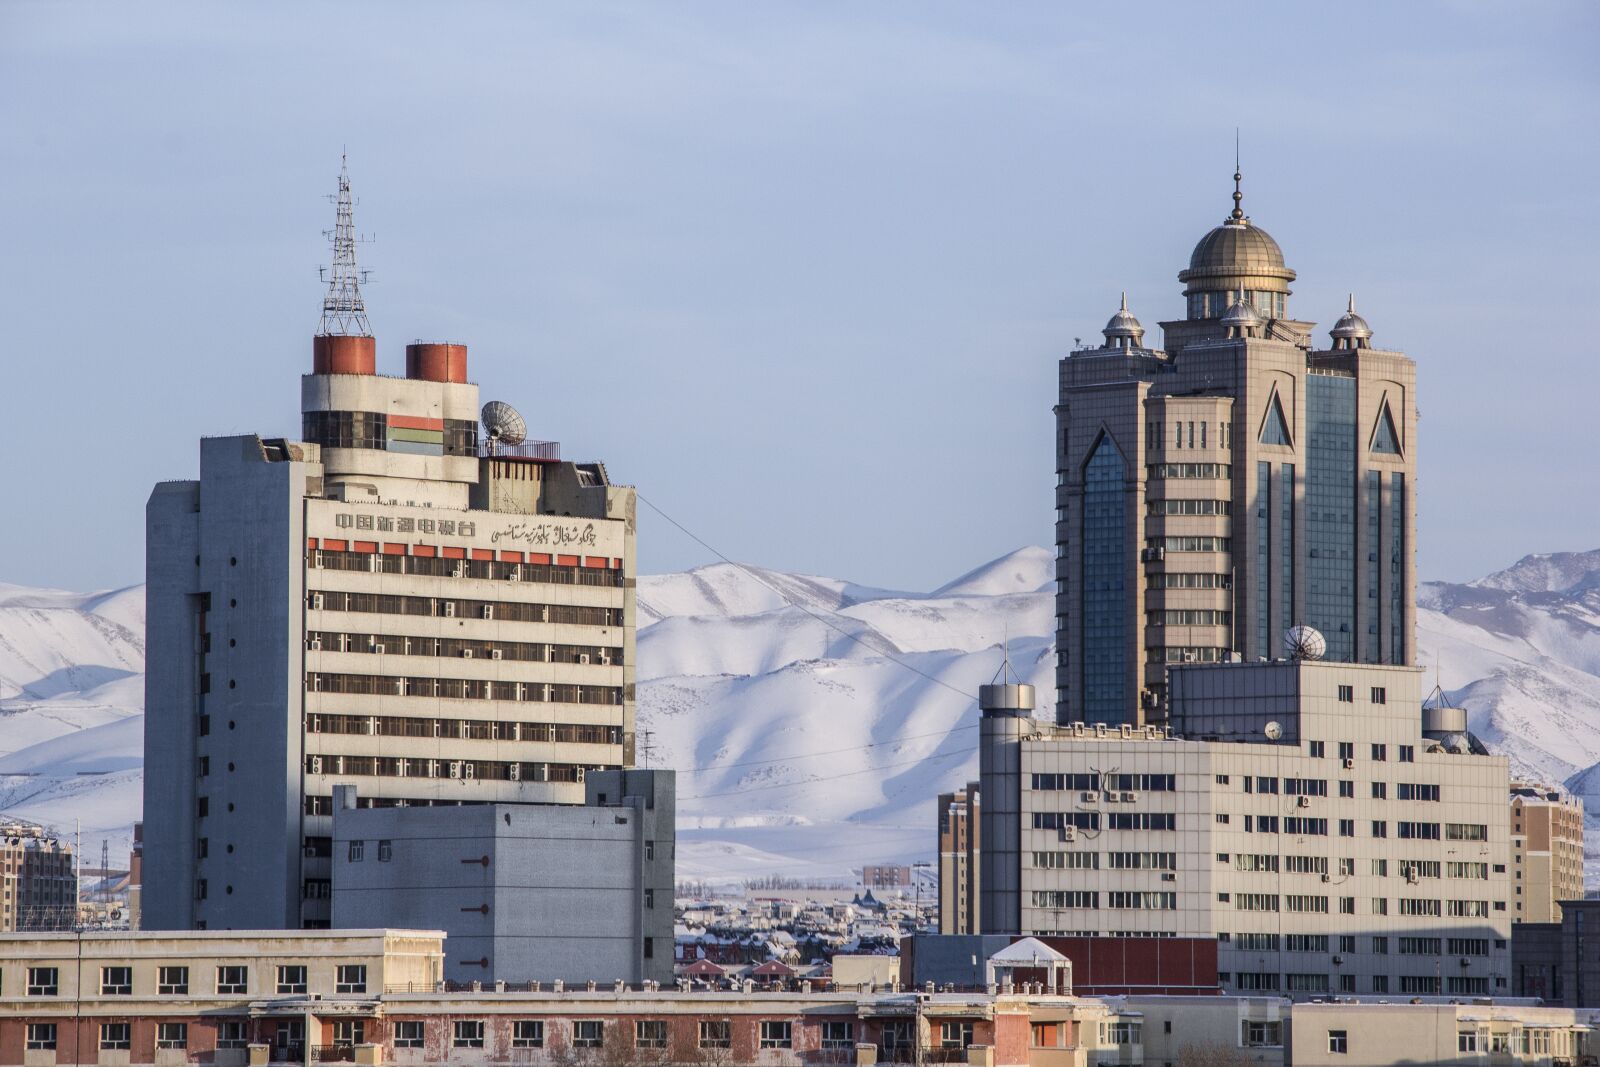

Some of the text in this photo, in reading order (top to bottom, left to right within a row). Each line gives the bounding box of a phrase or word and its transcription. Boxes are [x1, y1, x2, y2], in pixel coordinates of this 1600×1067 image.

[336, 513, 475, 537] 中国新疆电视台
